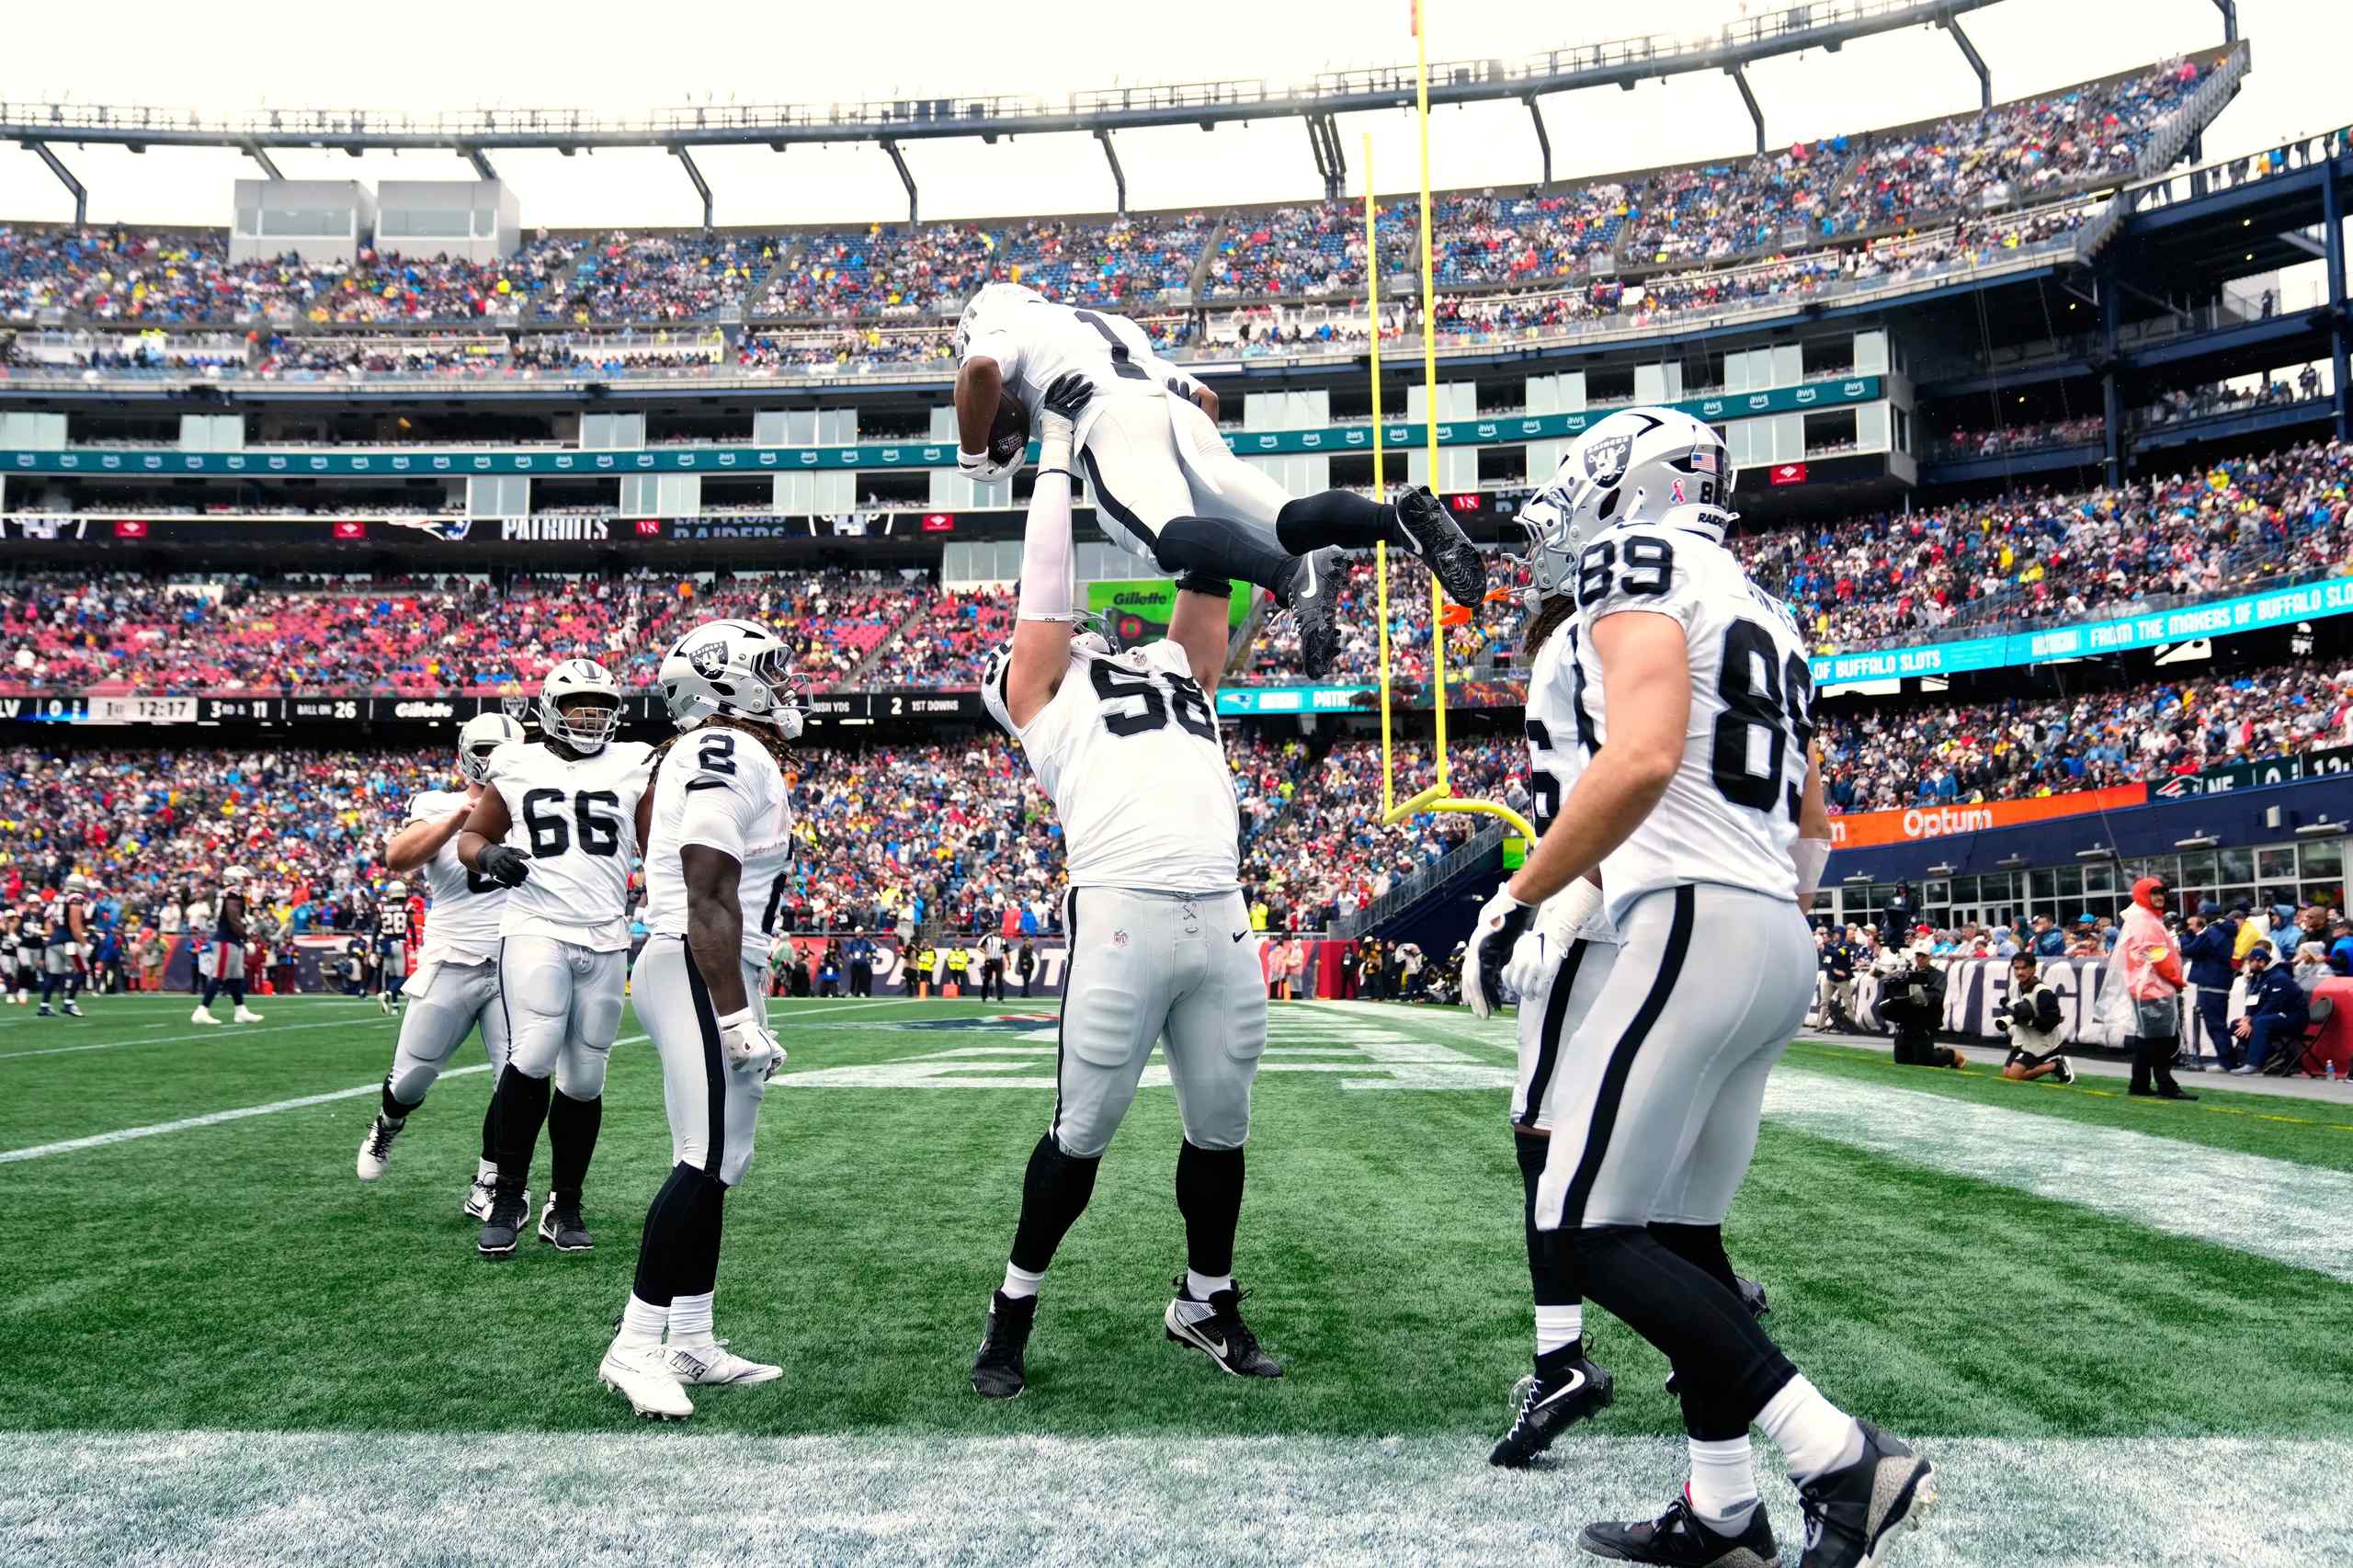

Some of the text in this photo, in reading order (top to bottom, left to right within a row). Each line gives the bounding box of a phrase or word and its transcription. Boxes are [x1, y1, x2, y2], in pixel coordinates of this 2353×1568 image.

[1074, 310, 1152, 381] 1
[1478, 425, 1496, 435] aws
[1522, 421, 1540, 431] aws
[1567, 416, 1586, 427] aws
[1704, 401, 1722, 413] aws
[1750, 395, 1768, 407] aws
[1797, 388, 1816, 401] aws
[1845, 381, 1865, 394] aws
[1578, 535, 1674, 607] 89
[1114, 591, 1167, 606] Gillette
[2089, 622, 2133, 648] FROM
[2136, 617, 2165, 641] THE
[2168, 607, 2232, 636] MAKERS
[2234, 604, 2252, 625] OF
[2256, 589, 2322, 621] BUFFALO
[2326, 583, 2353, 608] SLO
[1814, 662, 1831, 680] OF
[1836, 655, 1897, 677] BUFFALO
[1900, 649, 1941, 673] SLOTS
[49, 699, 63, 718] 0
[139, 701, 188, 718] 12:17
[253, 700, 268, 719] 11
[335, 701, 358, 719] 26
[891, 697, 902, 715] 2
[927, 699, 959, 712] DOWNS
[1711, 619, 1814, 825] 89
[699, 734, 736, 775] 2
[522, 789, 620, 859] 66
[1904, 808, 1993, 838] Optum
[381, 911, 407, 934] 28
